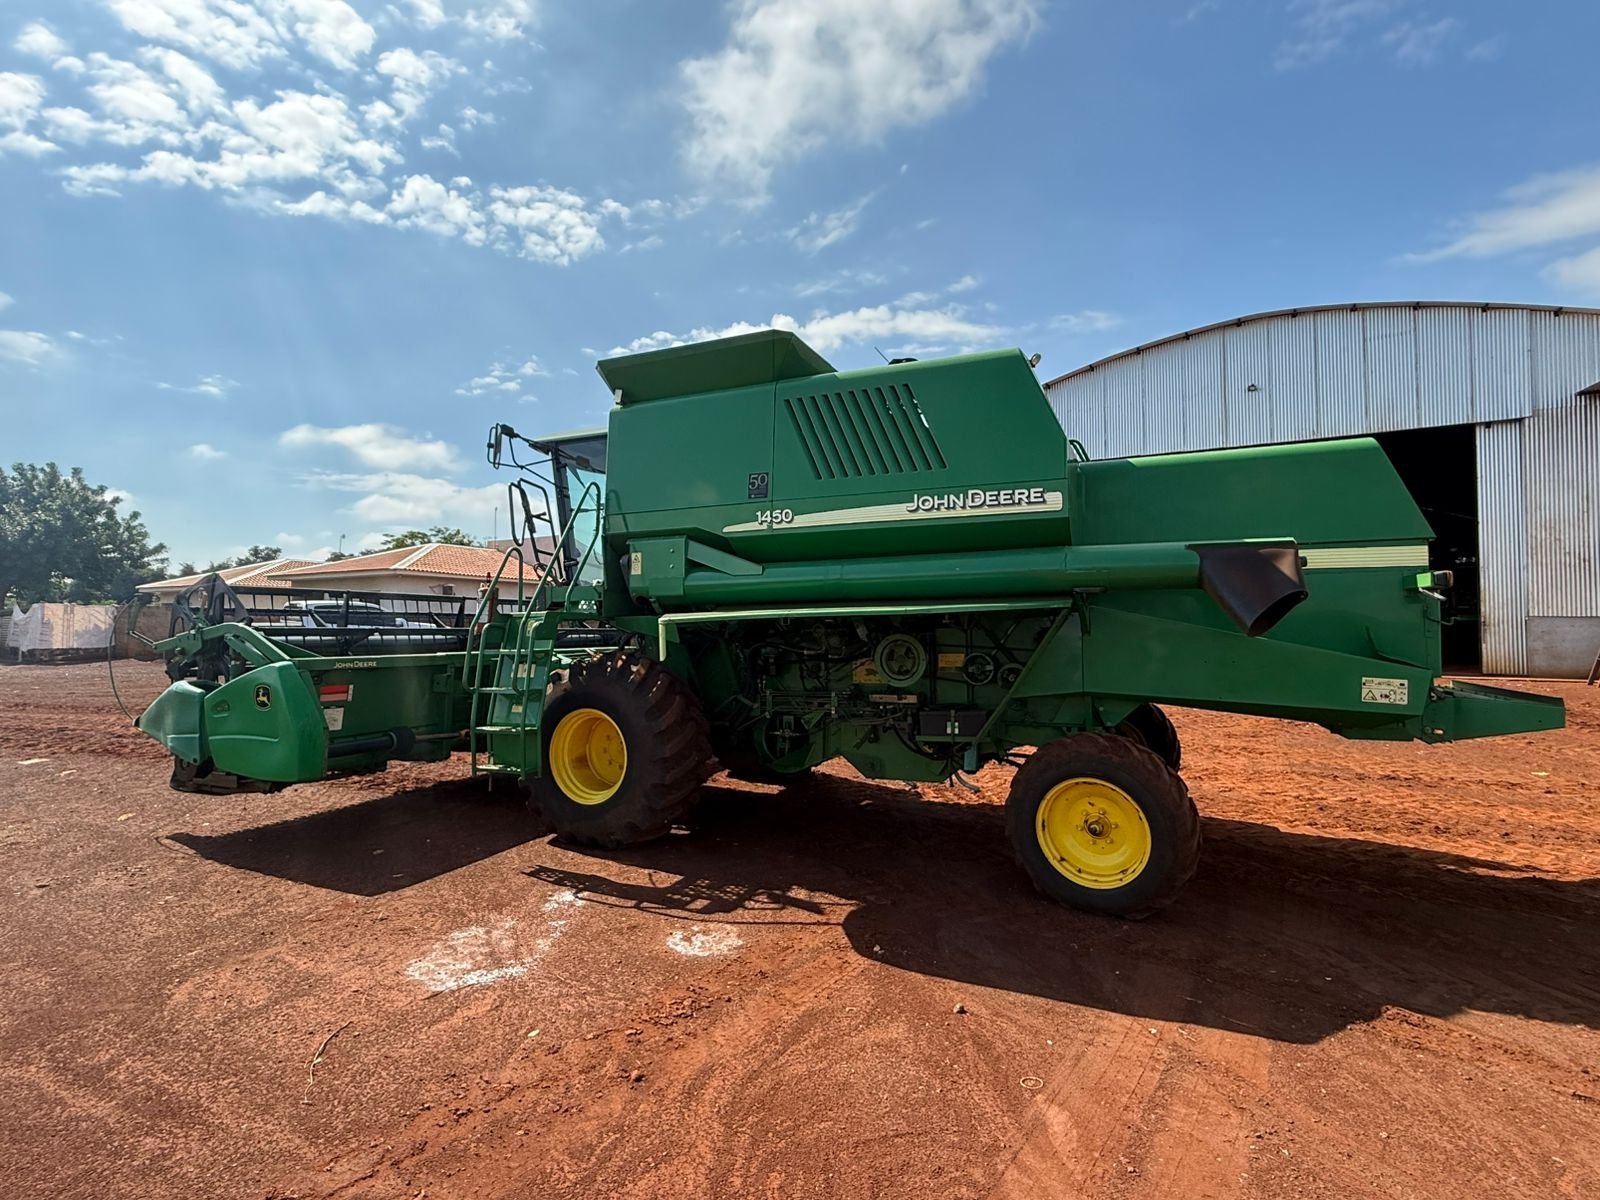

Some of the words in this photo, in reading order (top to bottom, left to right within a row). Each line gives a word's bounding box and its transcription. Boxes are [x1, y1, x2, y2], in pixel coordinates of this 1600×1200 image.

[749, 473, 768, 489] 50
[907, 493, 963, 511] JOHN
[968, 488, 1044, 506] DEERE
[756, 509, 793, 523] 1450
[334, 661, 353, 669] JOHN
